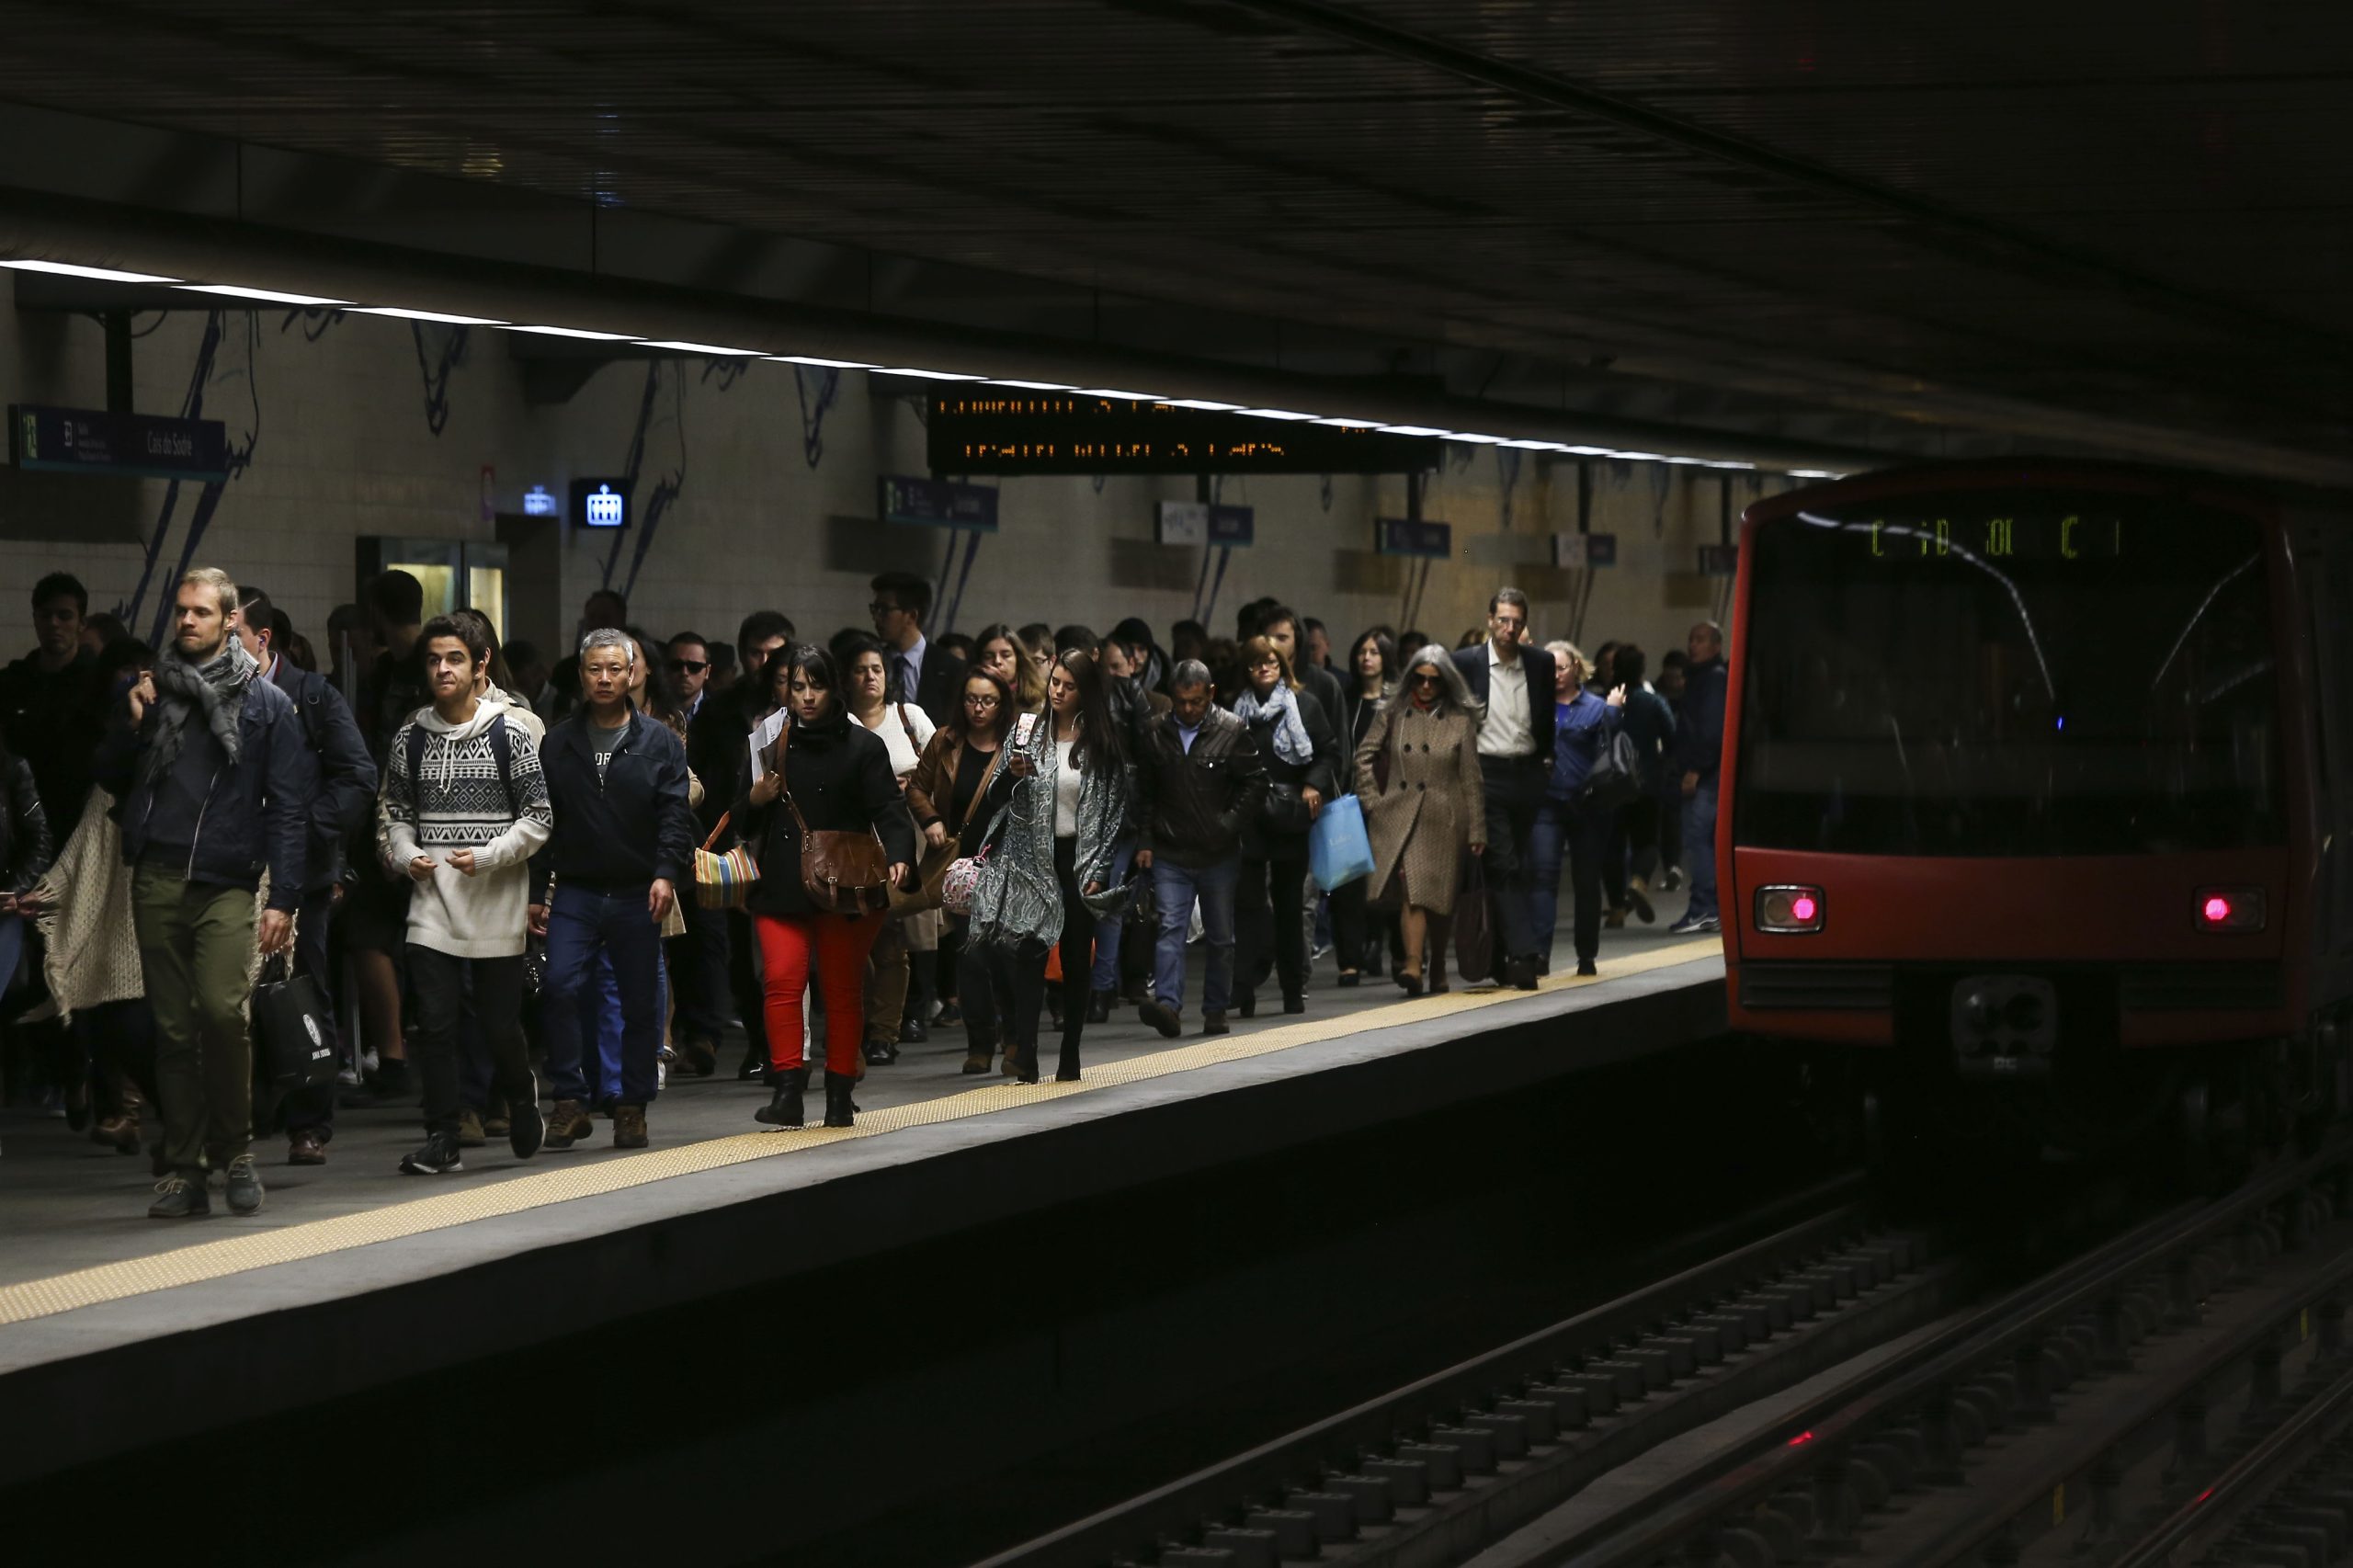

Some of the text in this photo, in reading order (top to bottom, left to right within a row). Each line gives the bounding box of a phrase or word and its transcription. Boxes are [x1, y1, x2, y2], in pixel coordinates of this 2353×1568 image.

[147, 430, 192, 456] Cais do Sodré
